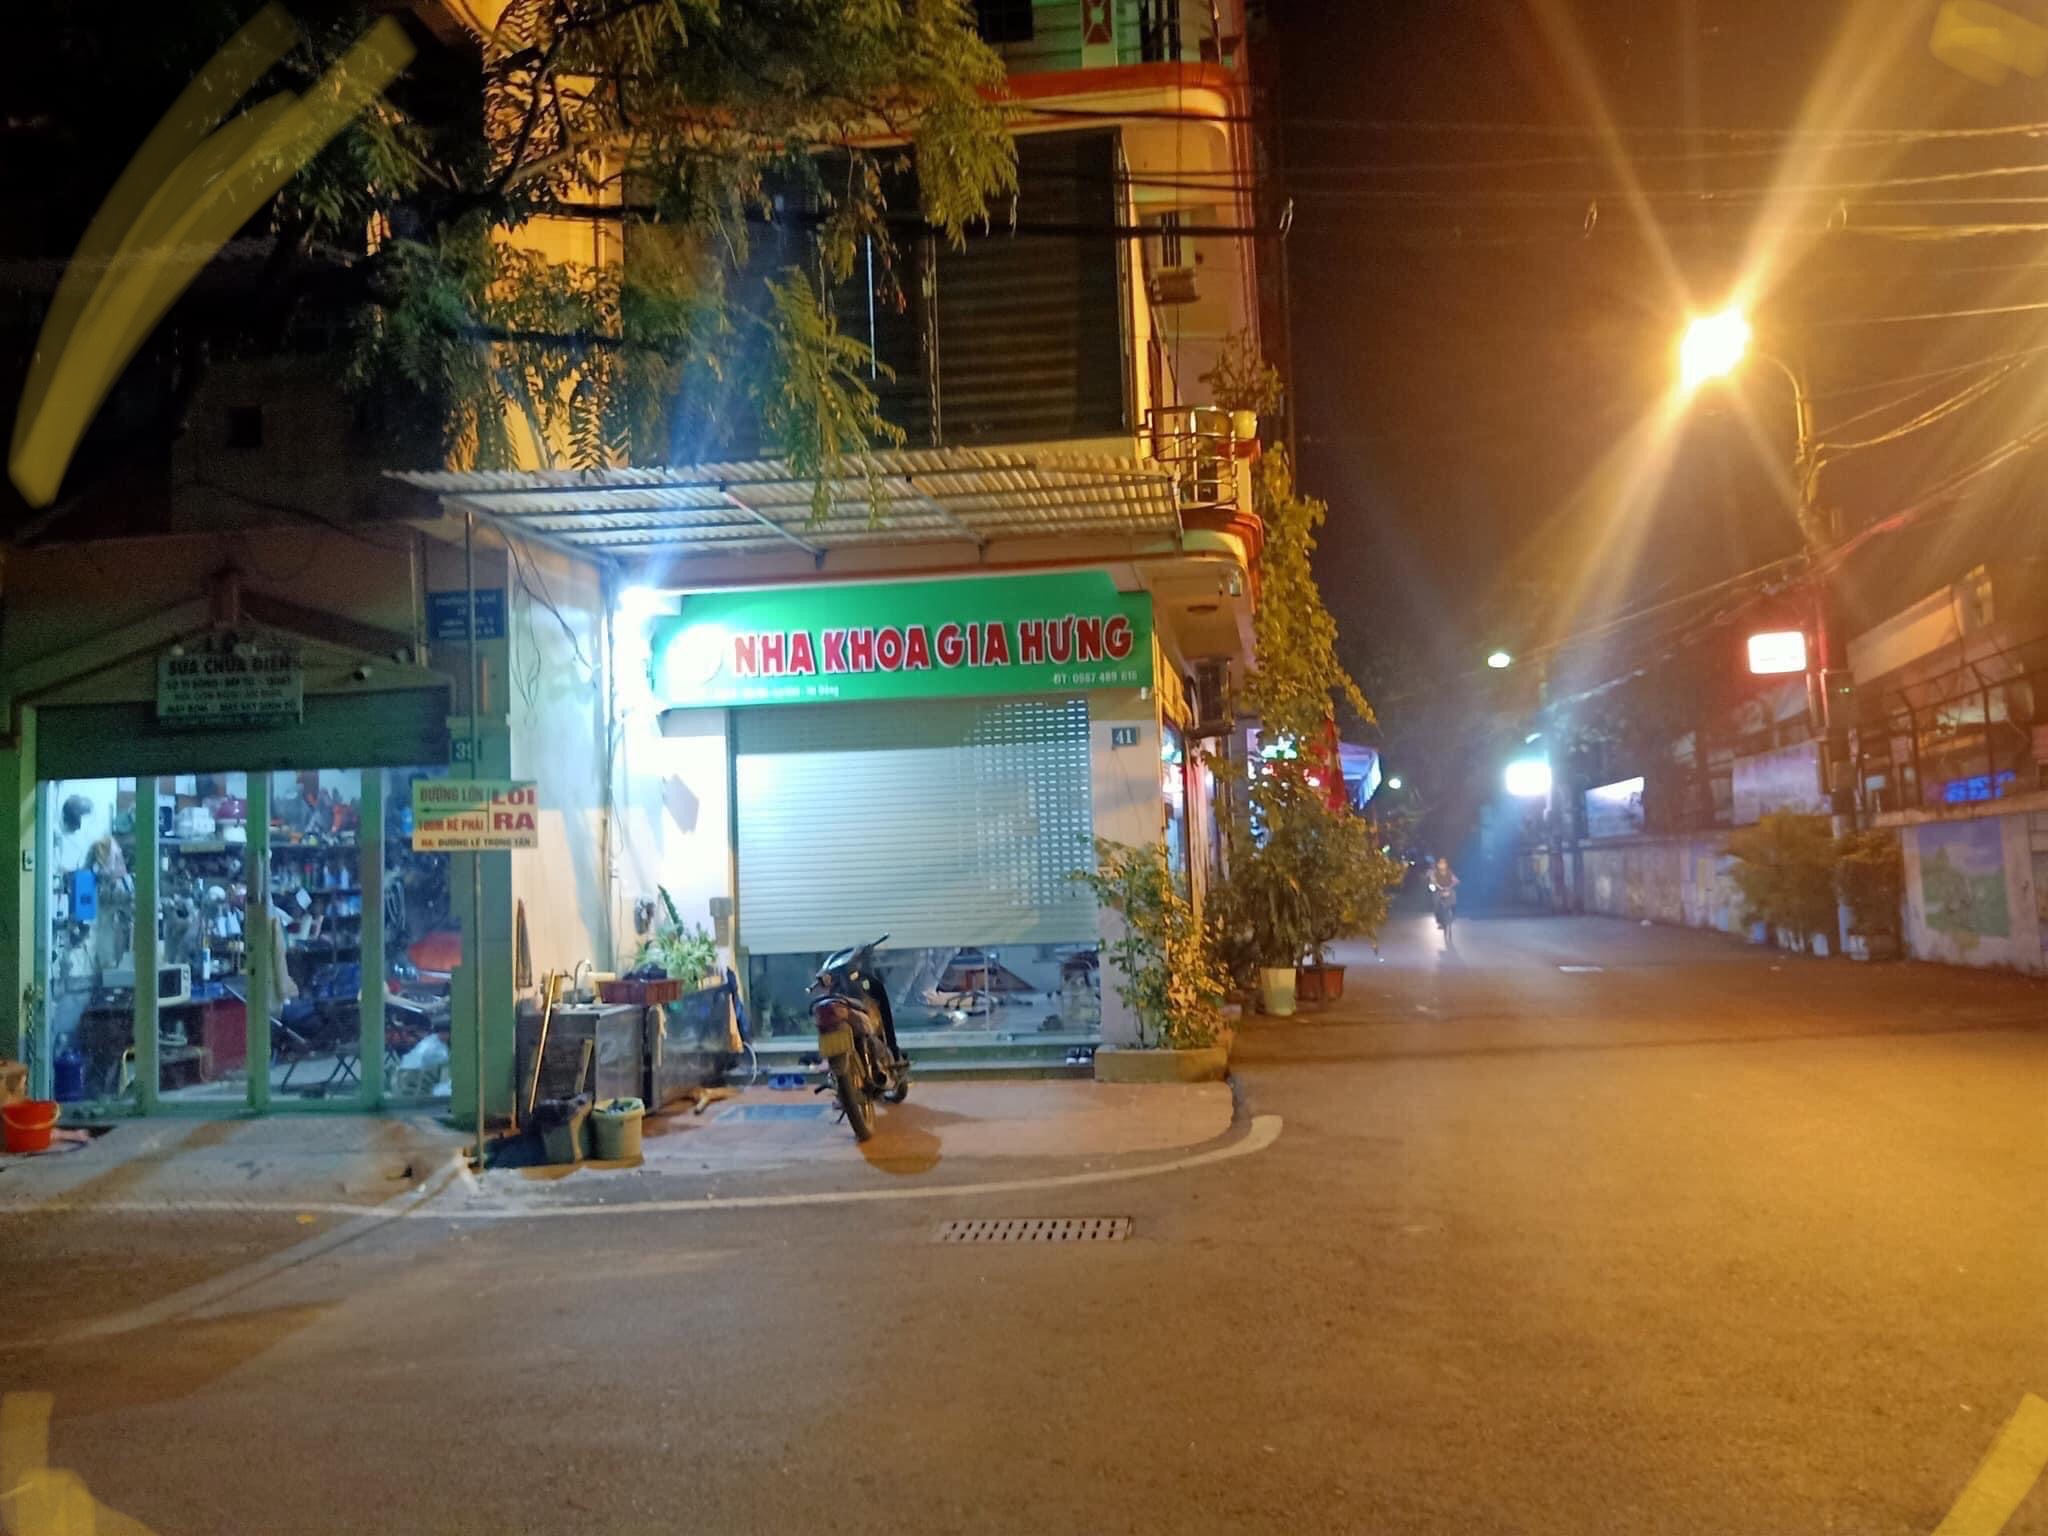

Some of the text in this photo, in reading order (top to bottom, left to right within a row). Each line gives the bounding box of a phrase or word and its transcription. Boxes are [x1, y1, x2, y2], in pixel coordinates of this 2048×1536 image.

[733, 612, 1135, 677] NHA KHOA GIA HƯNG
[494, 812, 536, 831] RA
